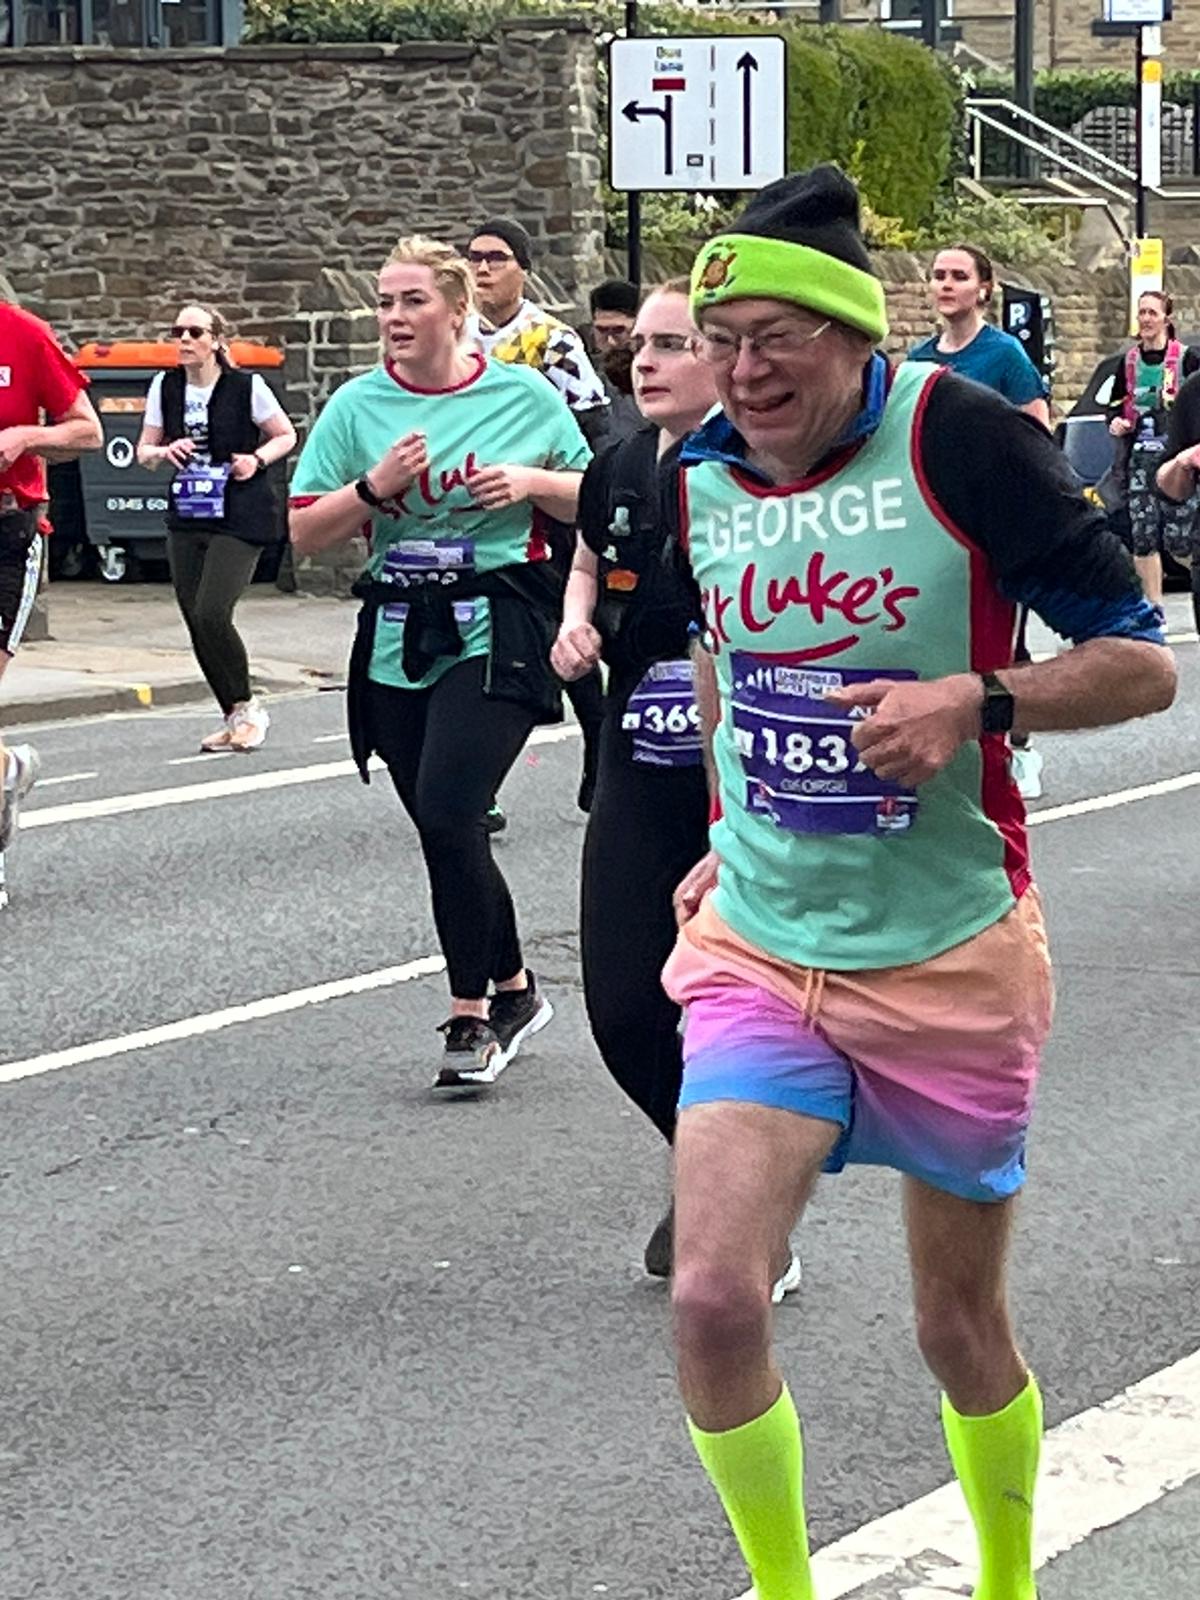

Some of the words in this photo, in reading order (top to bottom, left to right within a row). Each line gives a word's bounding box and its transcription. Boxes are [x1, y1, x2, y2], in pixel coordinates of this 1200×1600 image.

[707, 478, 907, 558] GEORGE
[740, 551, 920, 633] Luke's
[761, 727, 867, 774] 183
